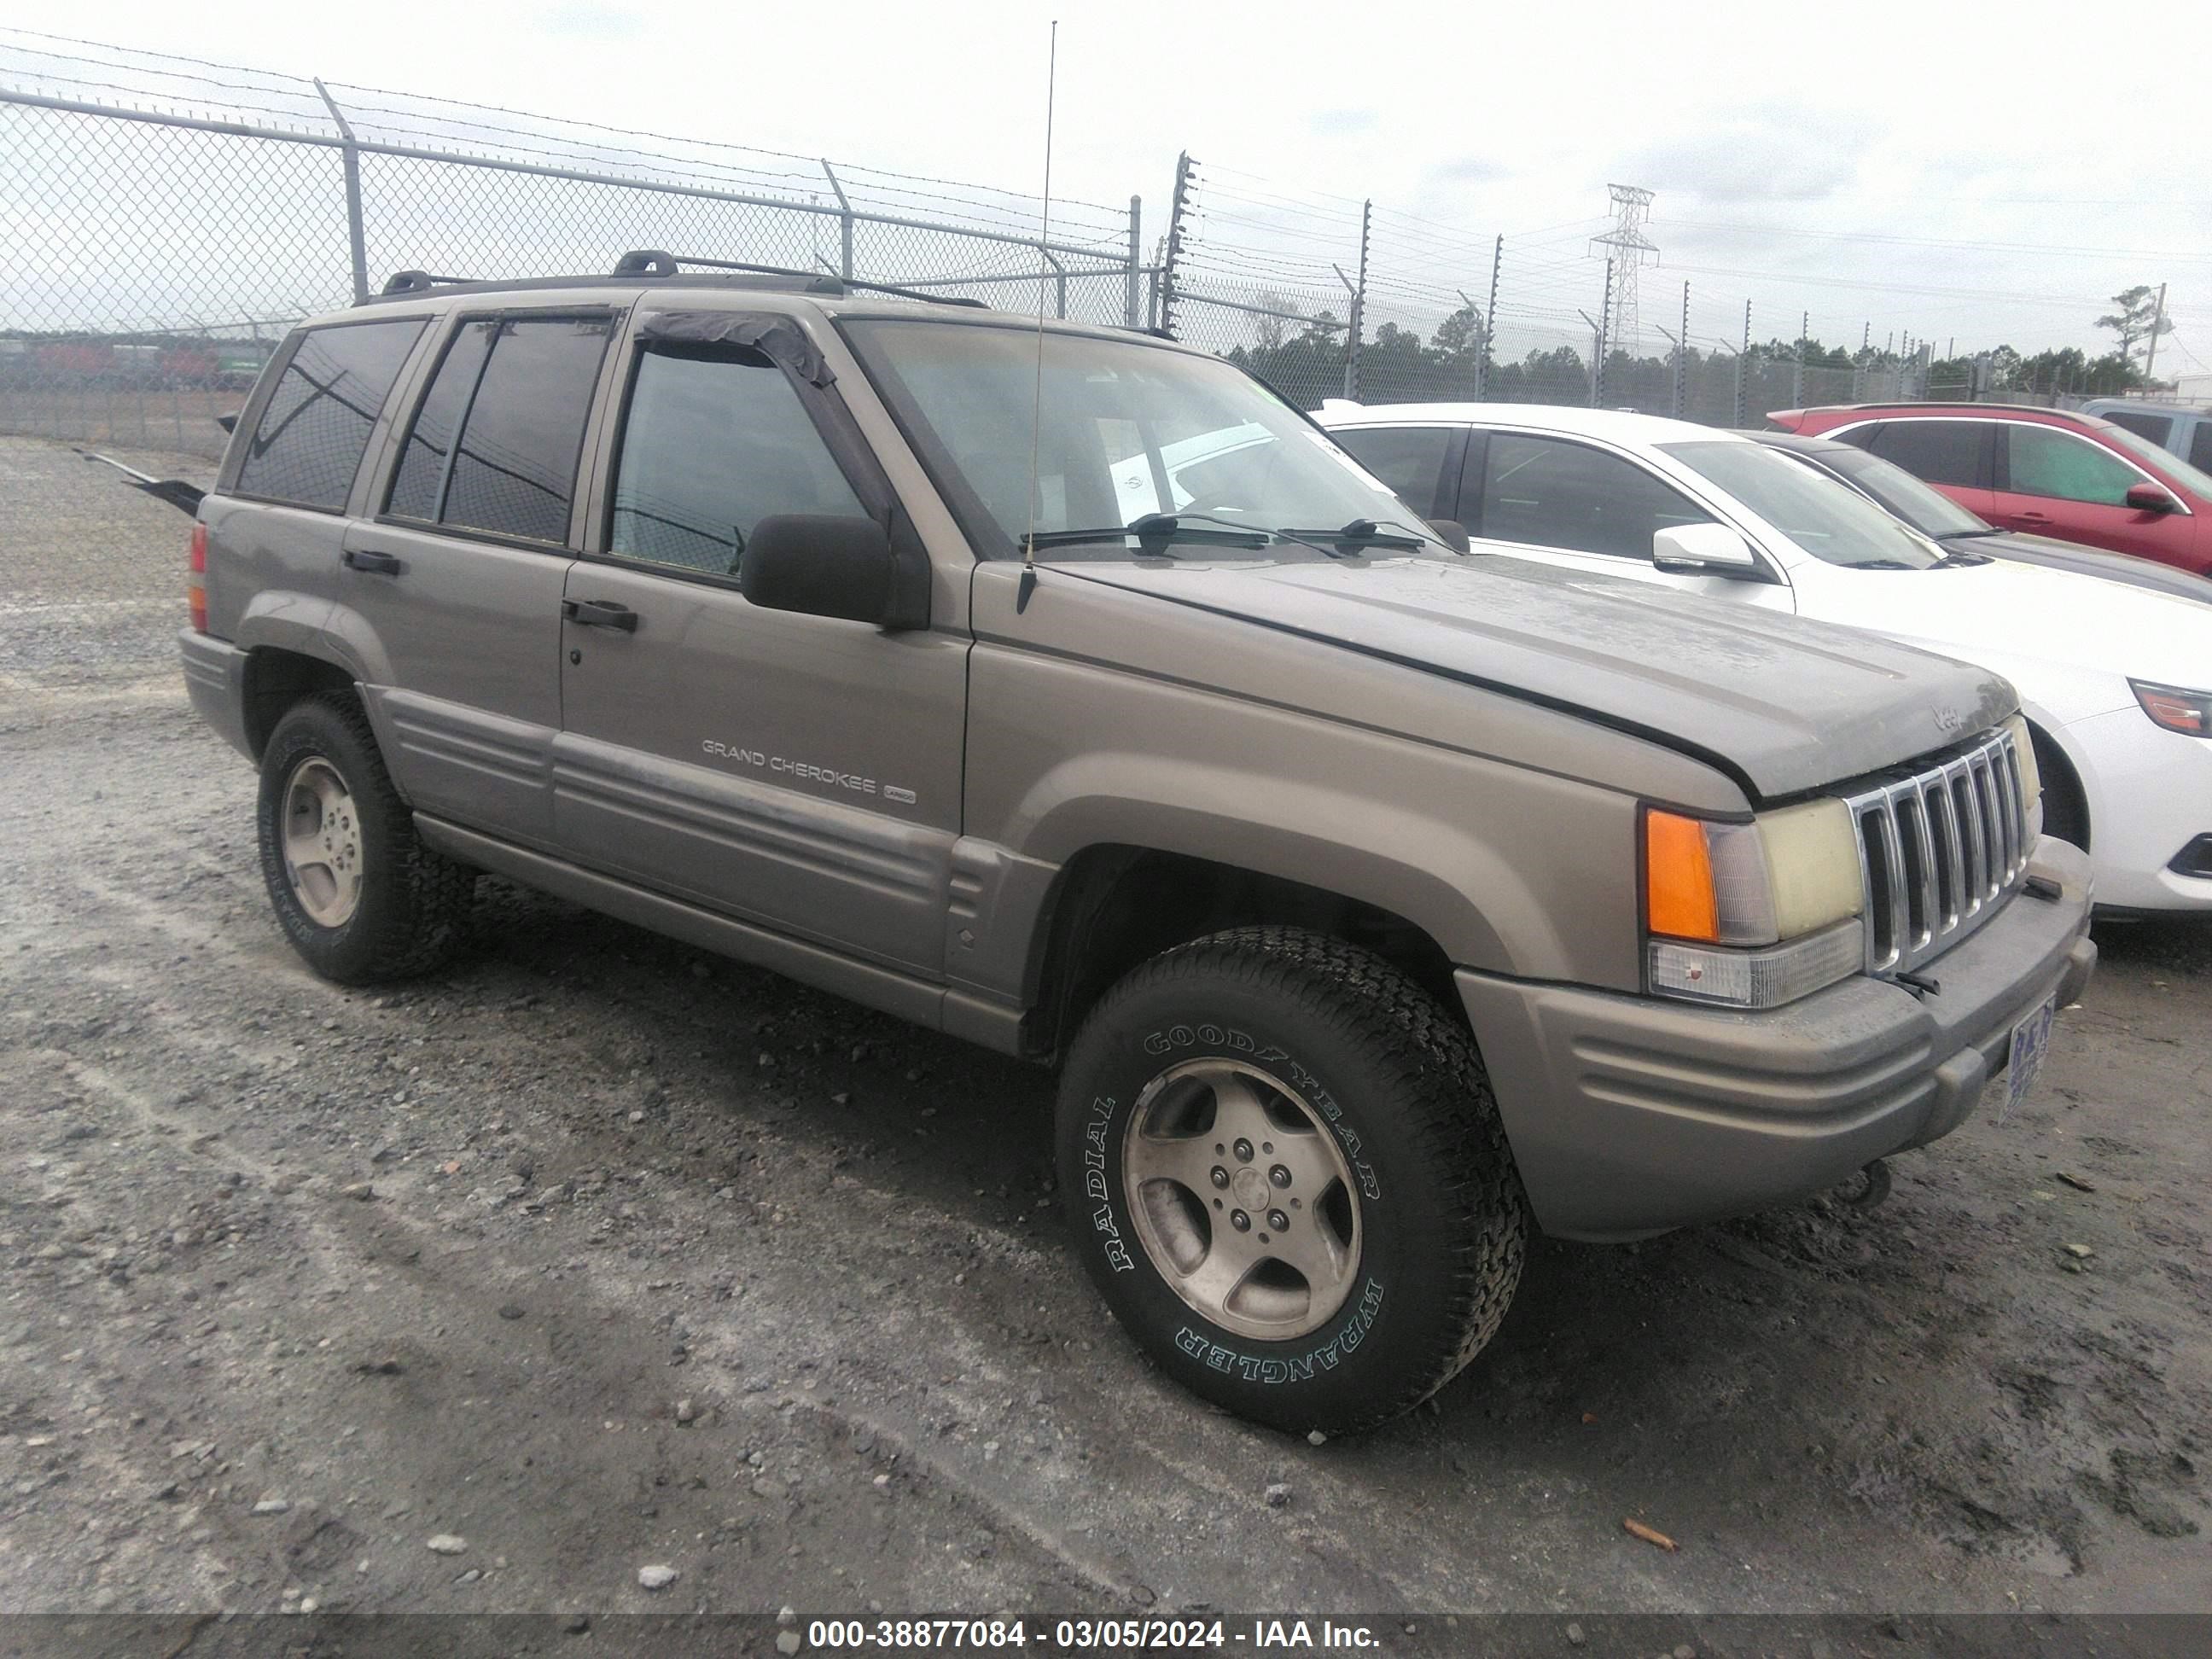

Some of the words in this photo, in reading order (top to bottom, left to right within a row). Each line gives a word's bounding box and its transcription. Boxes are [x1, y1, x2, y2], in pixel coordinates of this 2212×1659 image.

[701, 739, 765, 766] GRAND
[770, 756, 877, 794] CHEROKEE
[1085, 1095, 1135, 1273] RADIAL
[1174, 1277, 1385, 1384] WRANGLER
